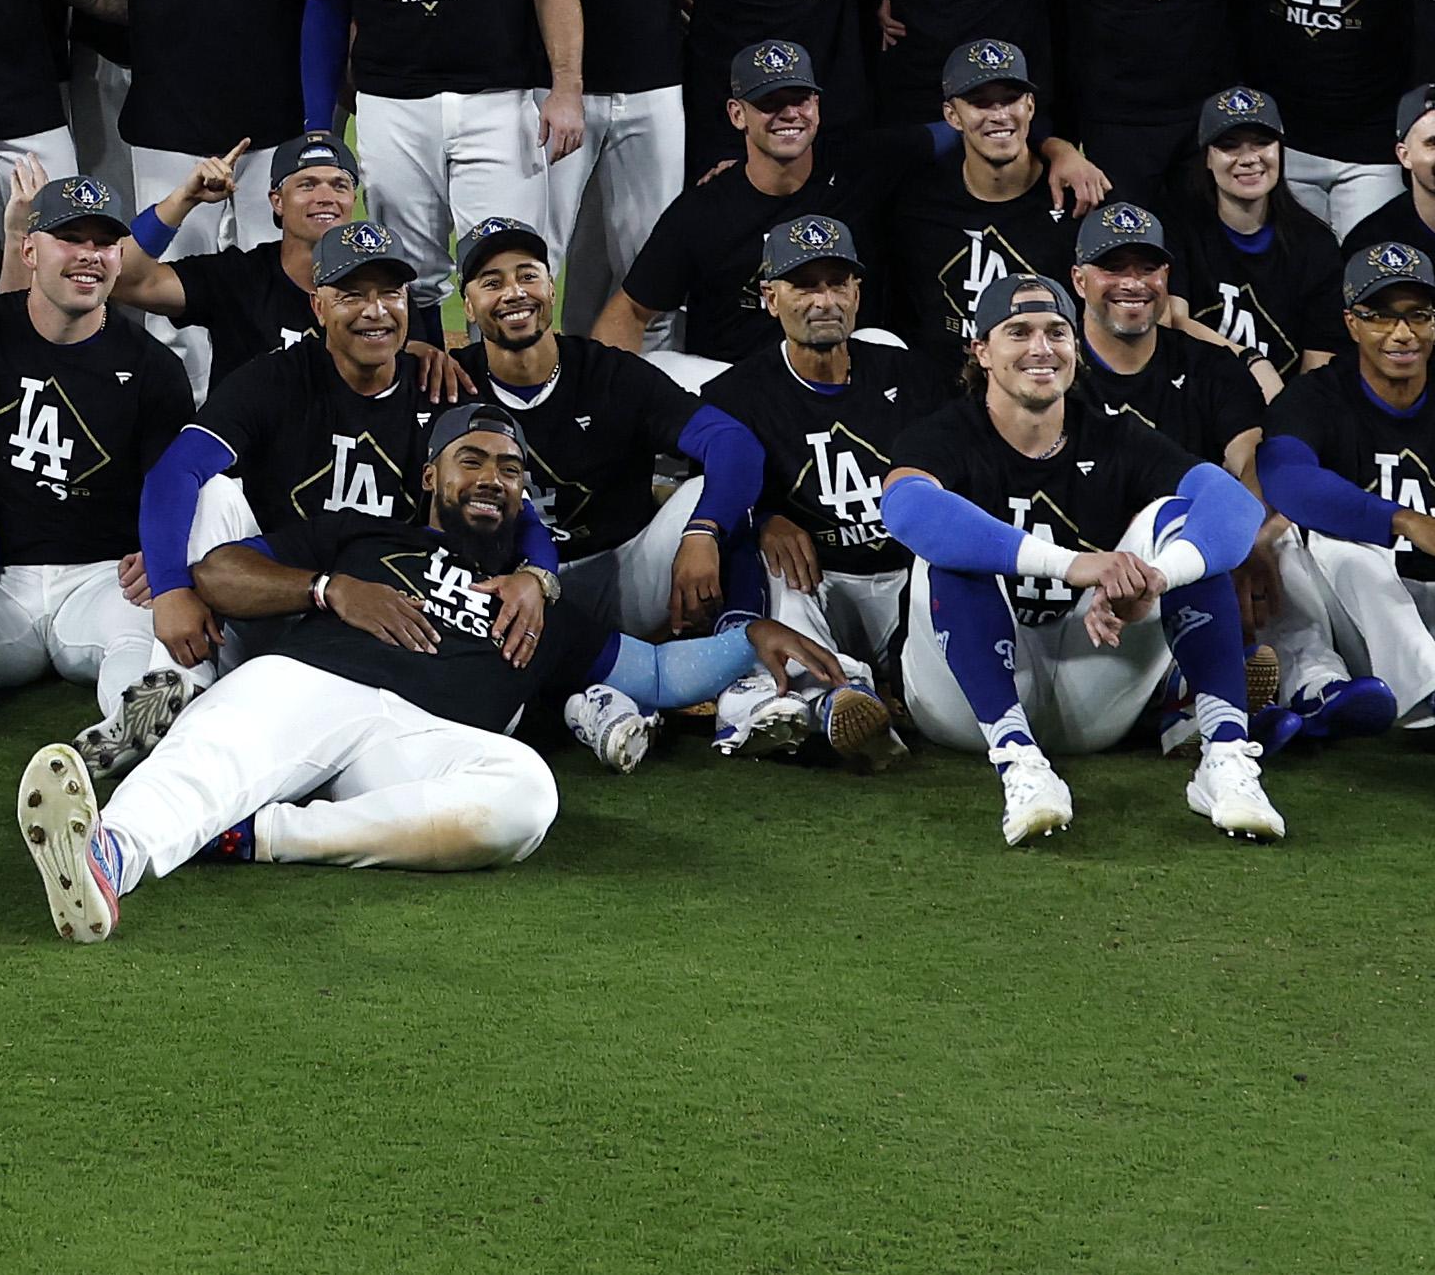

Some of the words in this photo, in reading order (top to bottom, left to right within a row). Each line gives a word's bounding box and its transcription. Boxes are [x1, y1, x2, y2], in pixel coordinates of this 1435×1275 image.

[1287, 7, 1341, 31] NLCS
[8, 377, 74, 480] LA
[322, 434, 395, 517] LA
[805, 430, 885, 523] LA
[422, 547, 494, 618] LA
